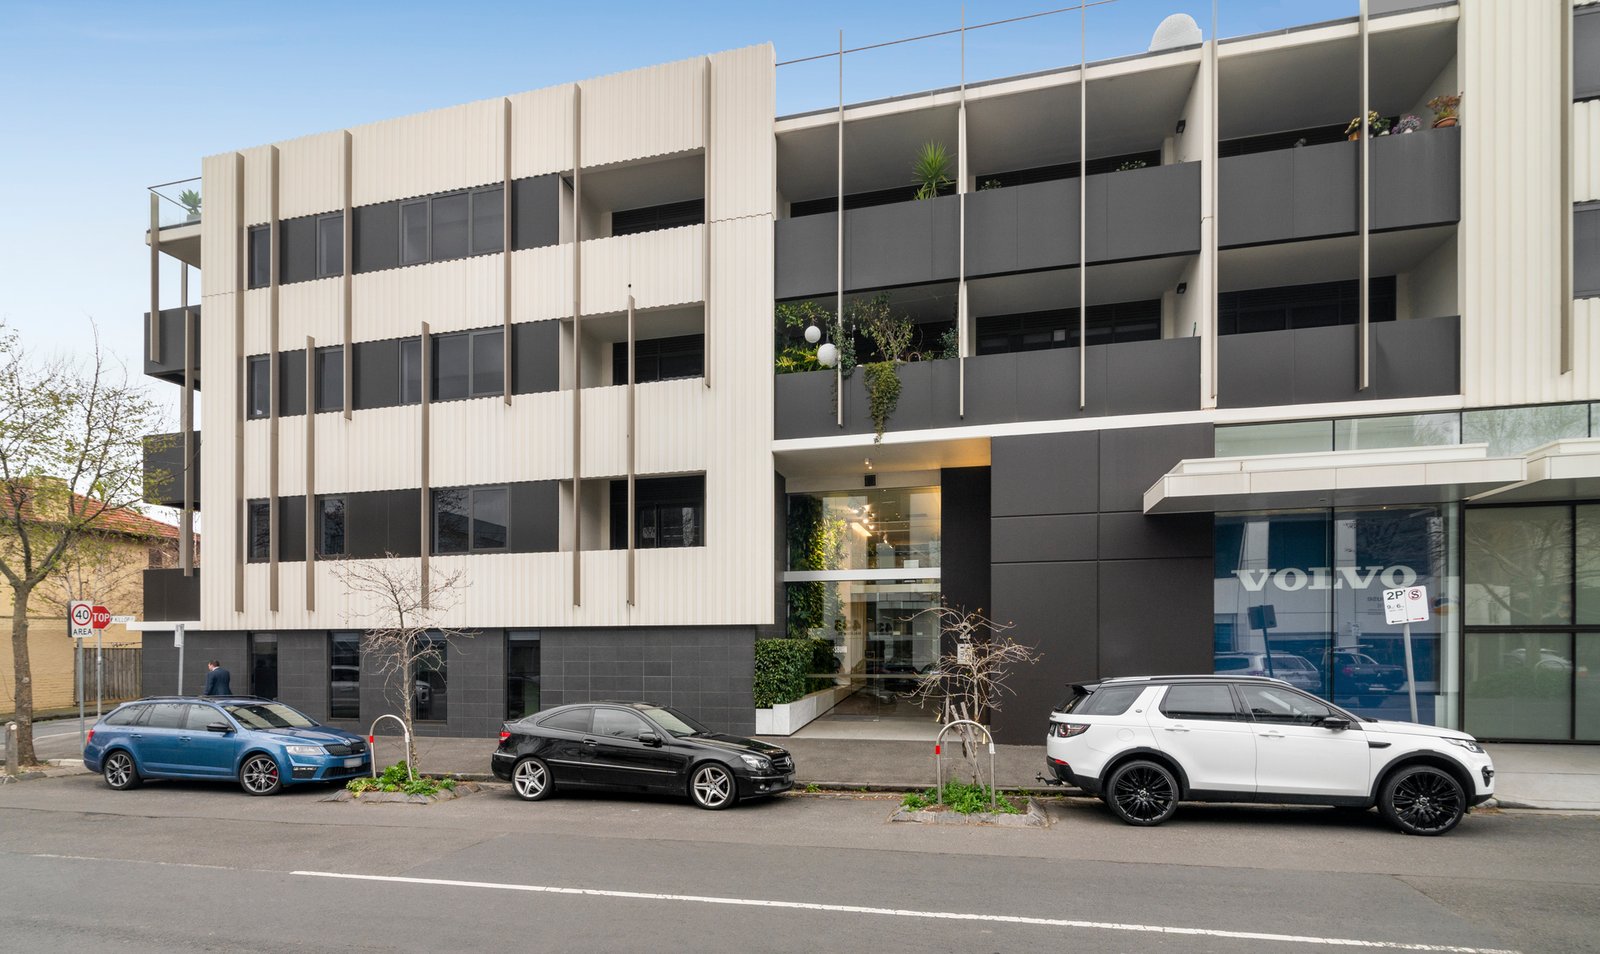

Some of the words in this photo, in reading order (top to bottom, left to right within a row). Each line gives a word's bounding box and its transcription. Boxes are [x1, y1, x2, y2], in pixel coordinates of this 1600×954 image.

[1231, 565, 1417, 591] VOLVO
[75, 610, 89, 620] 40
[92, 612, 110, 622] TOP
[73, 628, 92, 636] AREA
